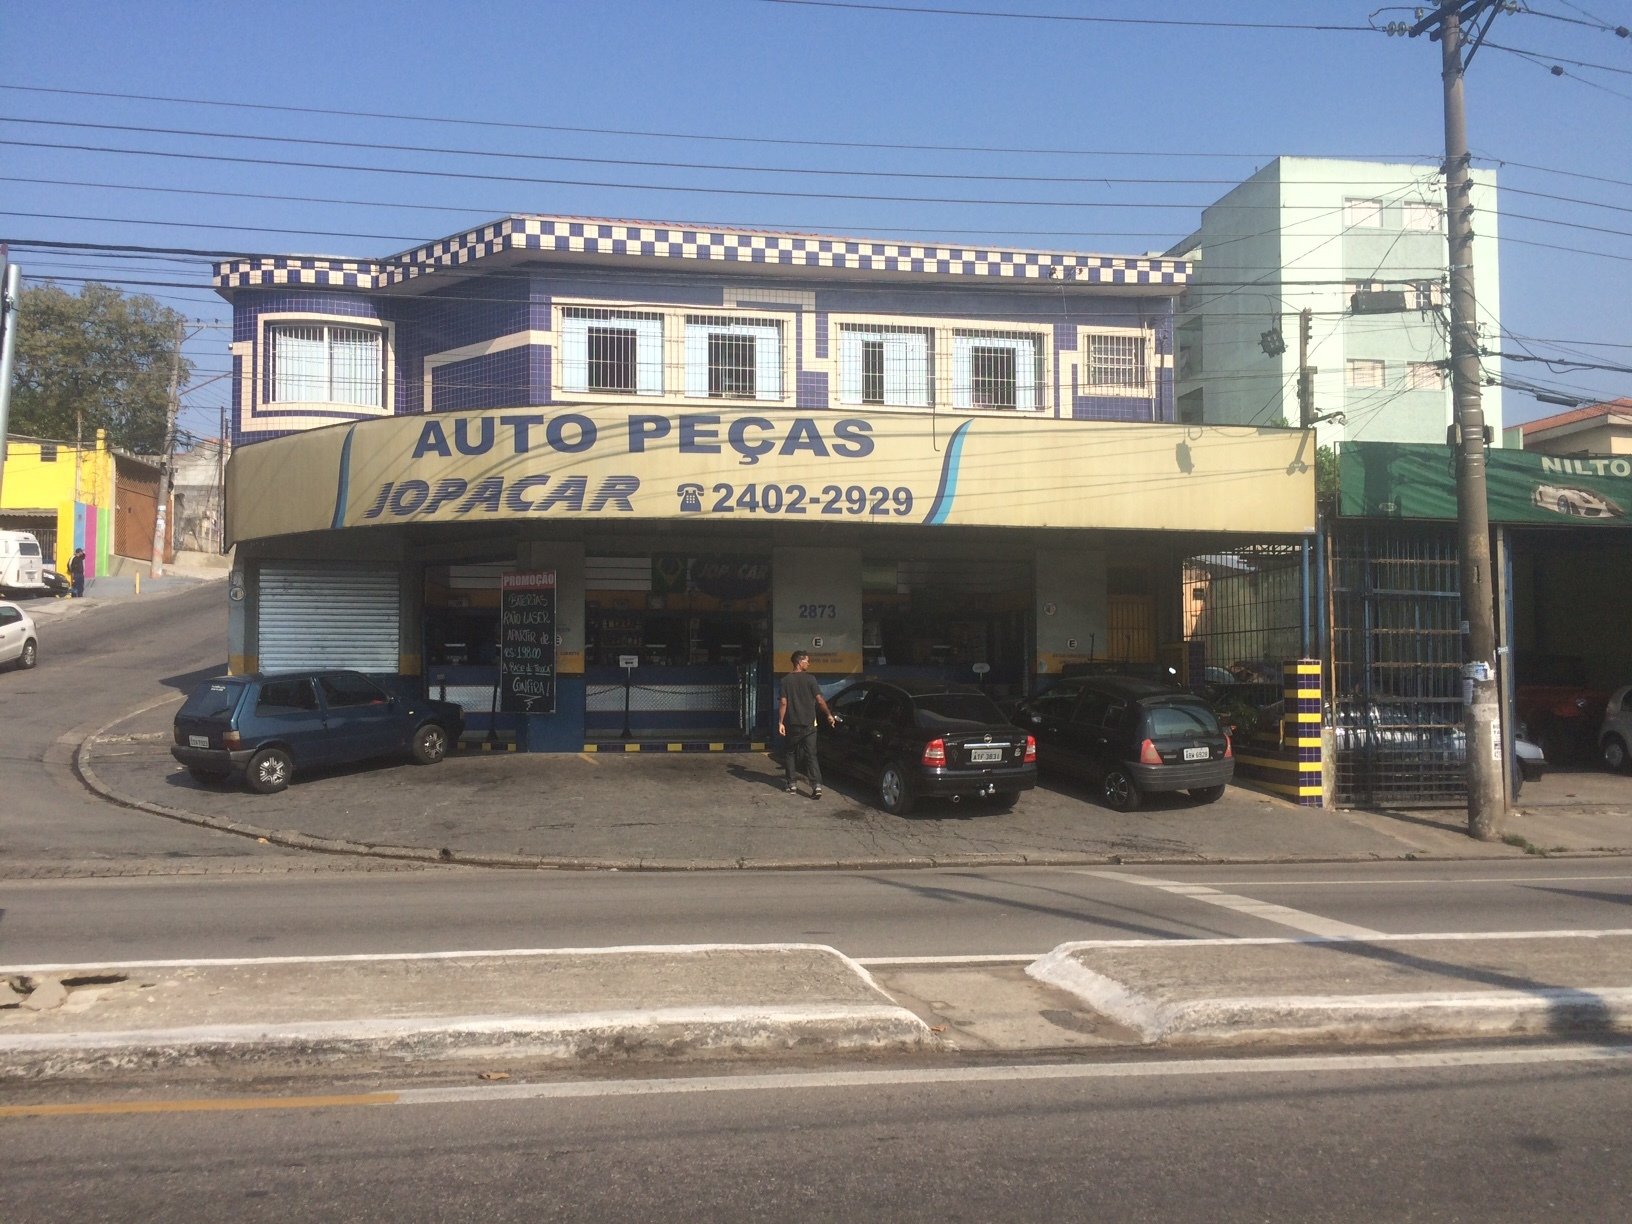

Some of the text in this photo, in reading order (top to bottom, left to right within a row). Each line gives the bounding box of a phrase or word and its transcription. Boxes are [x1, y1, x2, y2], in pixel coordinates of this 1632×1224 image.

[411, 413, 875, 465] AUTO PEÇAS
[1541, 456, 1631, 477] NILTO
[363, 474, 641, 518] JOPACAR
[711, 483, 914, 516] 2402-2929
[503, 573, 555, 587] PROMOÇÃO
[799, 604, 837, 618] 2873
